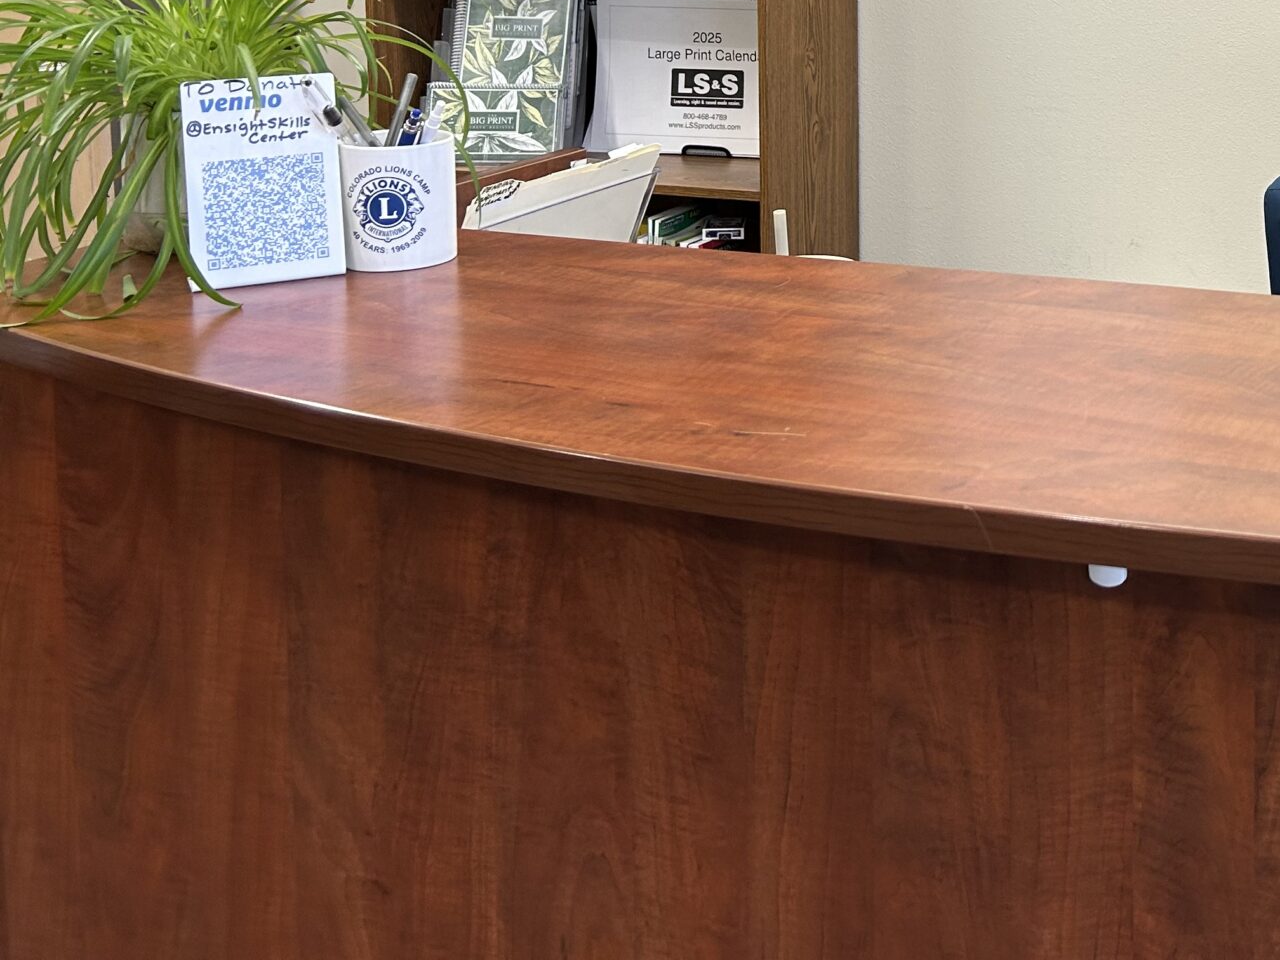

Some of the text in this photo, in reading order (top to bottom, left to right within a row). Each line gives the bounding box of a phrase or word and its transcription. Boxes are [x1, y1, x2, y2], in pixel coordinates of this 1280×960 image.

[693, 32, 722, 43] 2025
[648, 48, 759, 62] Large Print Calend
[224, 77, 301, 92] Donat
[678, 73, 738, 96] LS&S
[200, 94, 282, 113] venmo
[186, 115, 311, 137] @EnsightSkills
[470, 116, 513, 124] BIG PRINT
[668, 122, 741, 130] www.LSSproducts.com
[249, 130, 308, 144] Center
[347, 166, 431, 198] COLORADO LIONS CAMP
[366, 180, 408, 193] LIONS
[378, 197, 398, 219] L
[367, 225, 408, 236] INTERNATIONAL
[391, 228, 427, 253] 1969-2009
